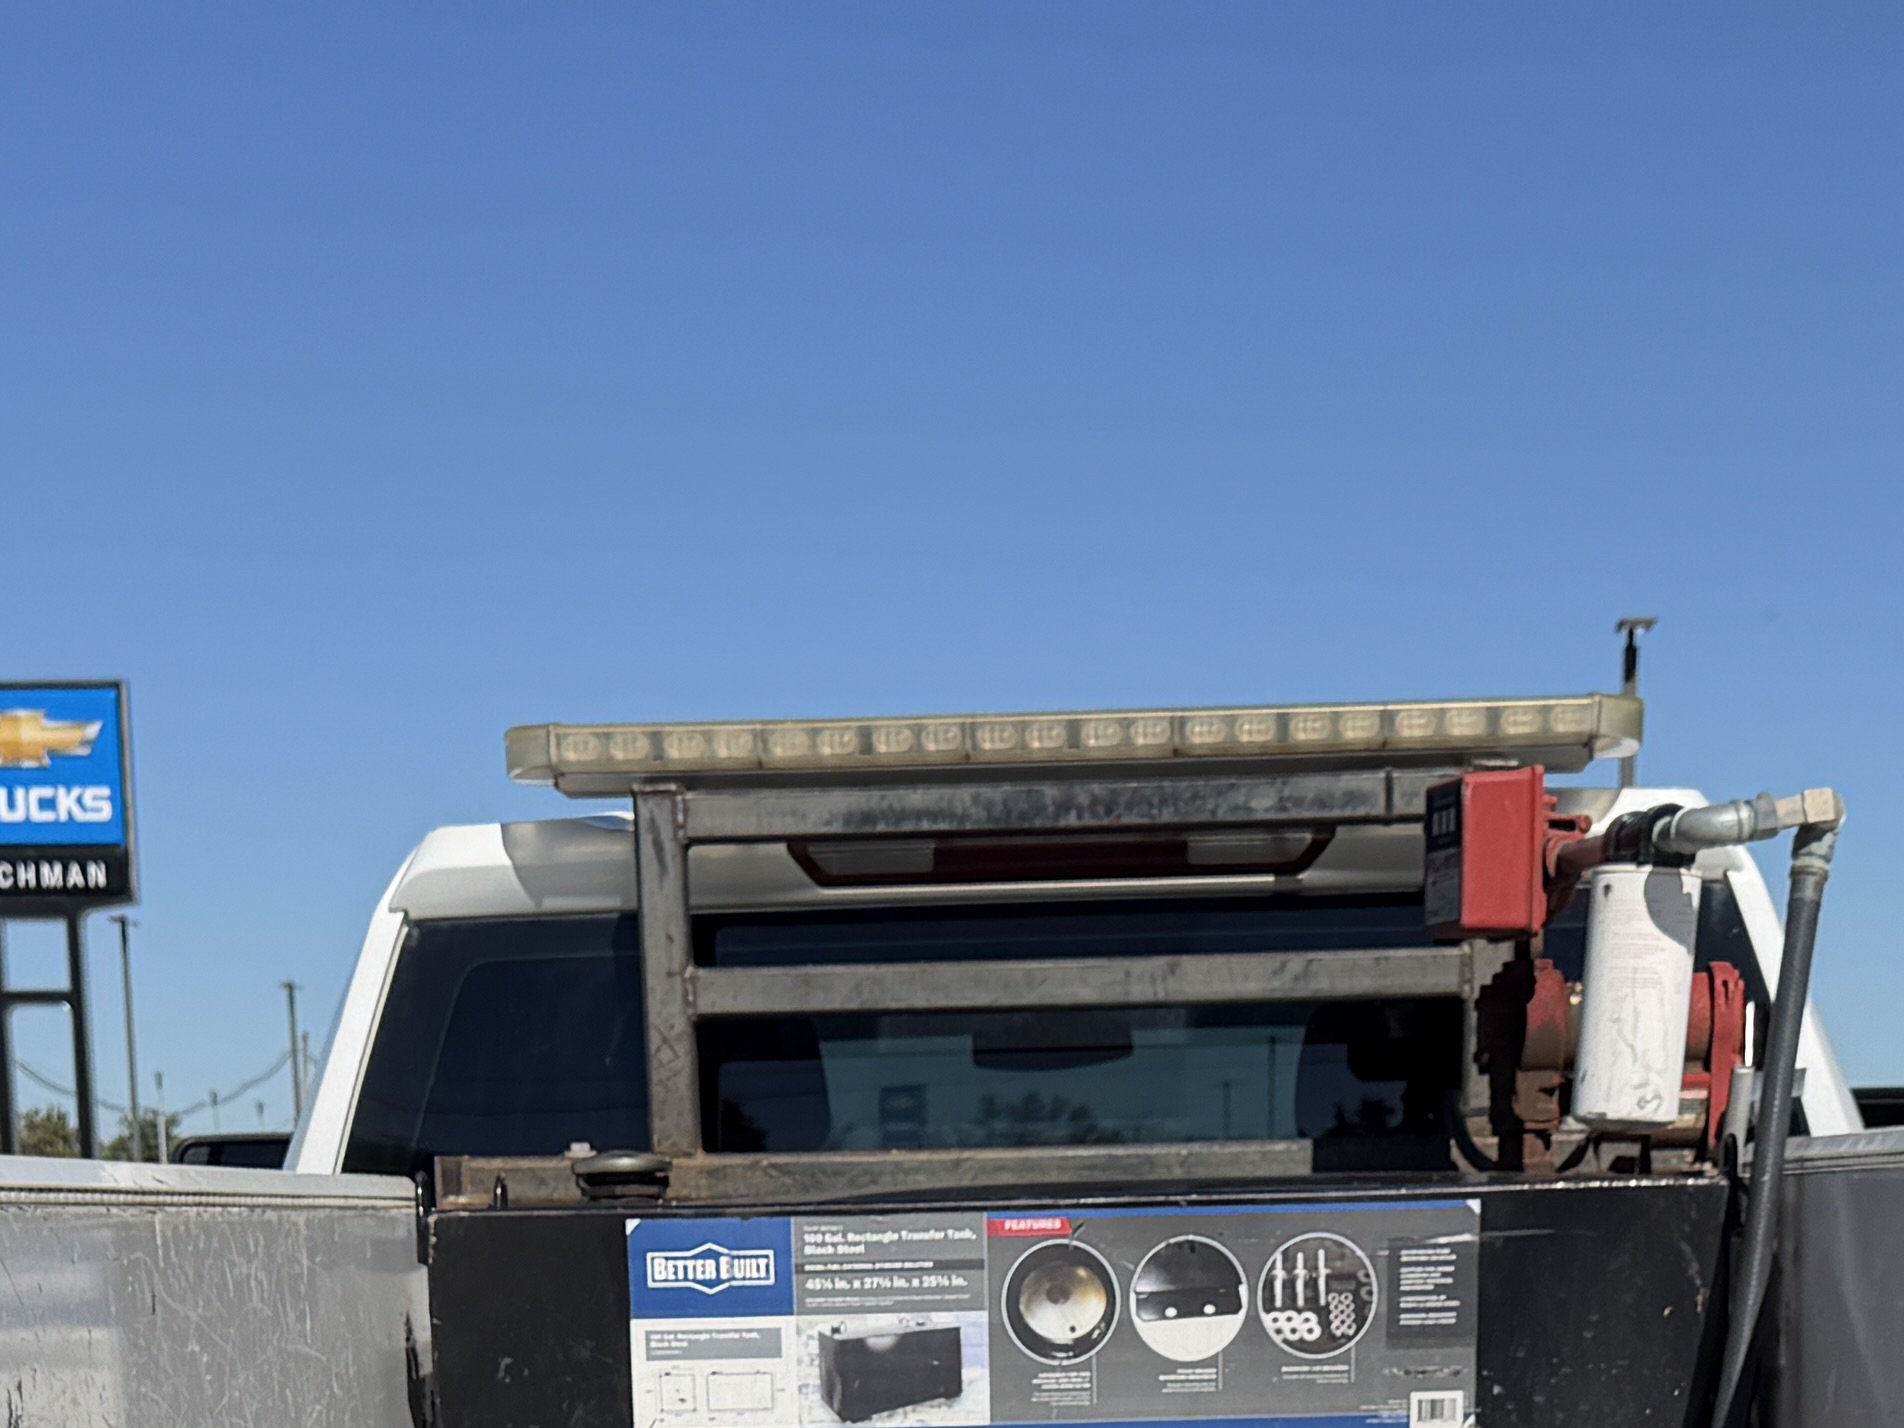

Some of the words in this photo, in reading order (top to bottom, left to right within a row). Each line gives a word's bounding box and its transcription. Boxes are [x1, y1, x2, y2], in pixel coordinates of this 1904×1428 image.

[1004, 1219, 1062, 1231] FEATURES
[901, 1229, 945, 1240] Transfer
[653, 1258, 714, 1281] BETTER
[719, 1257, 769, 1279] BUILT
